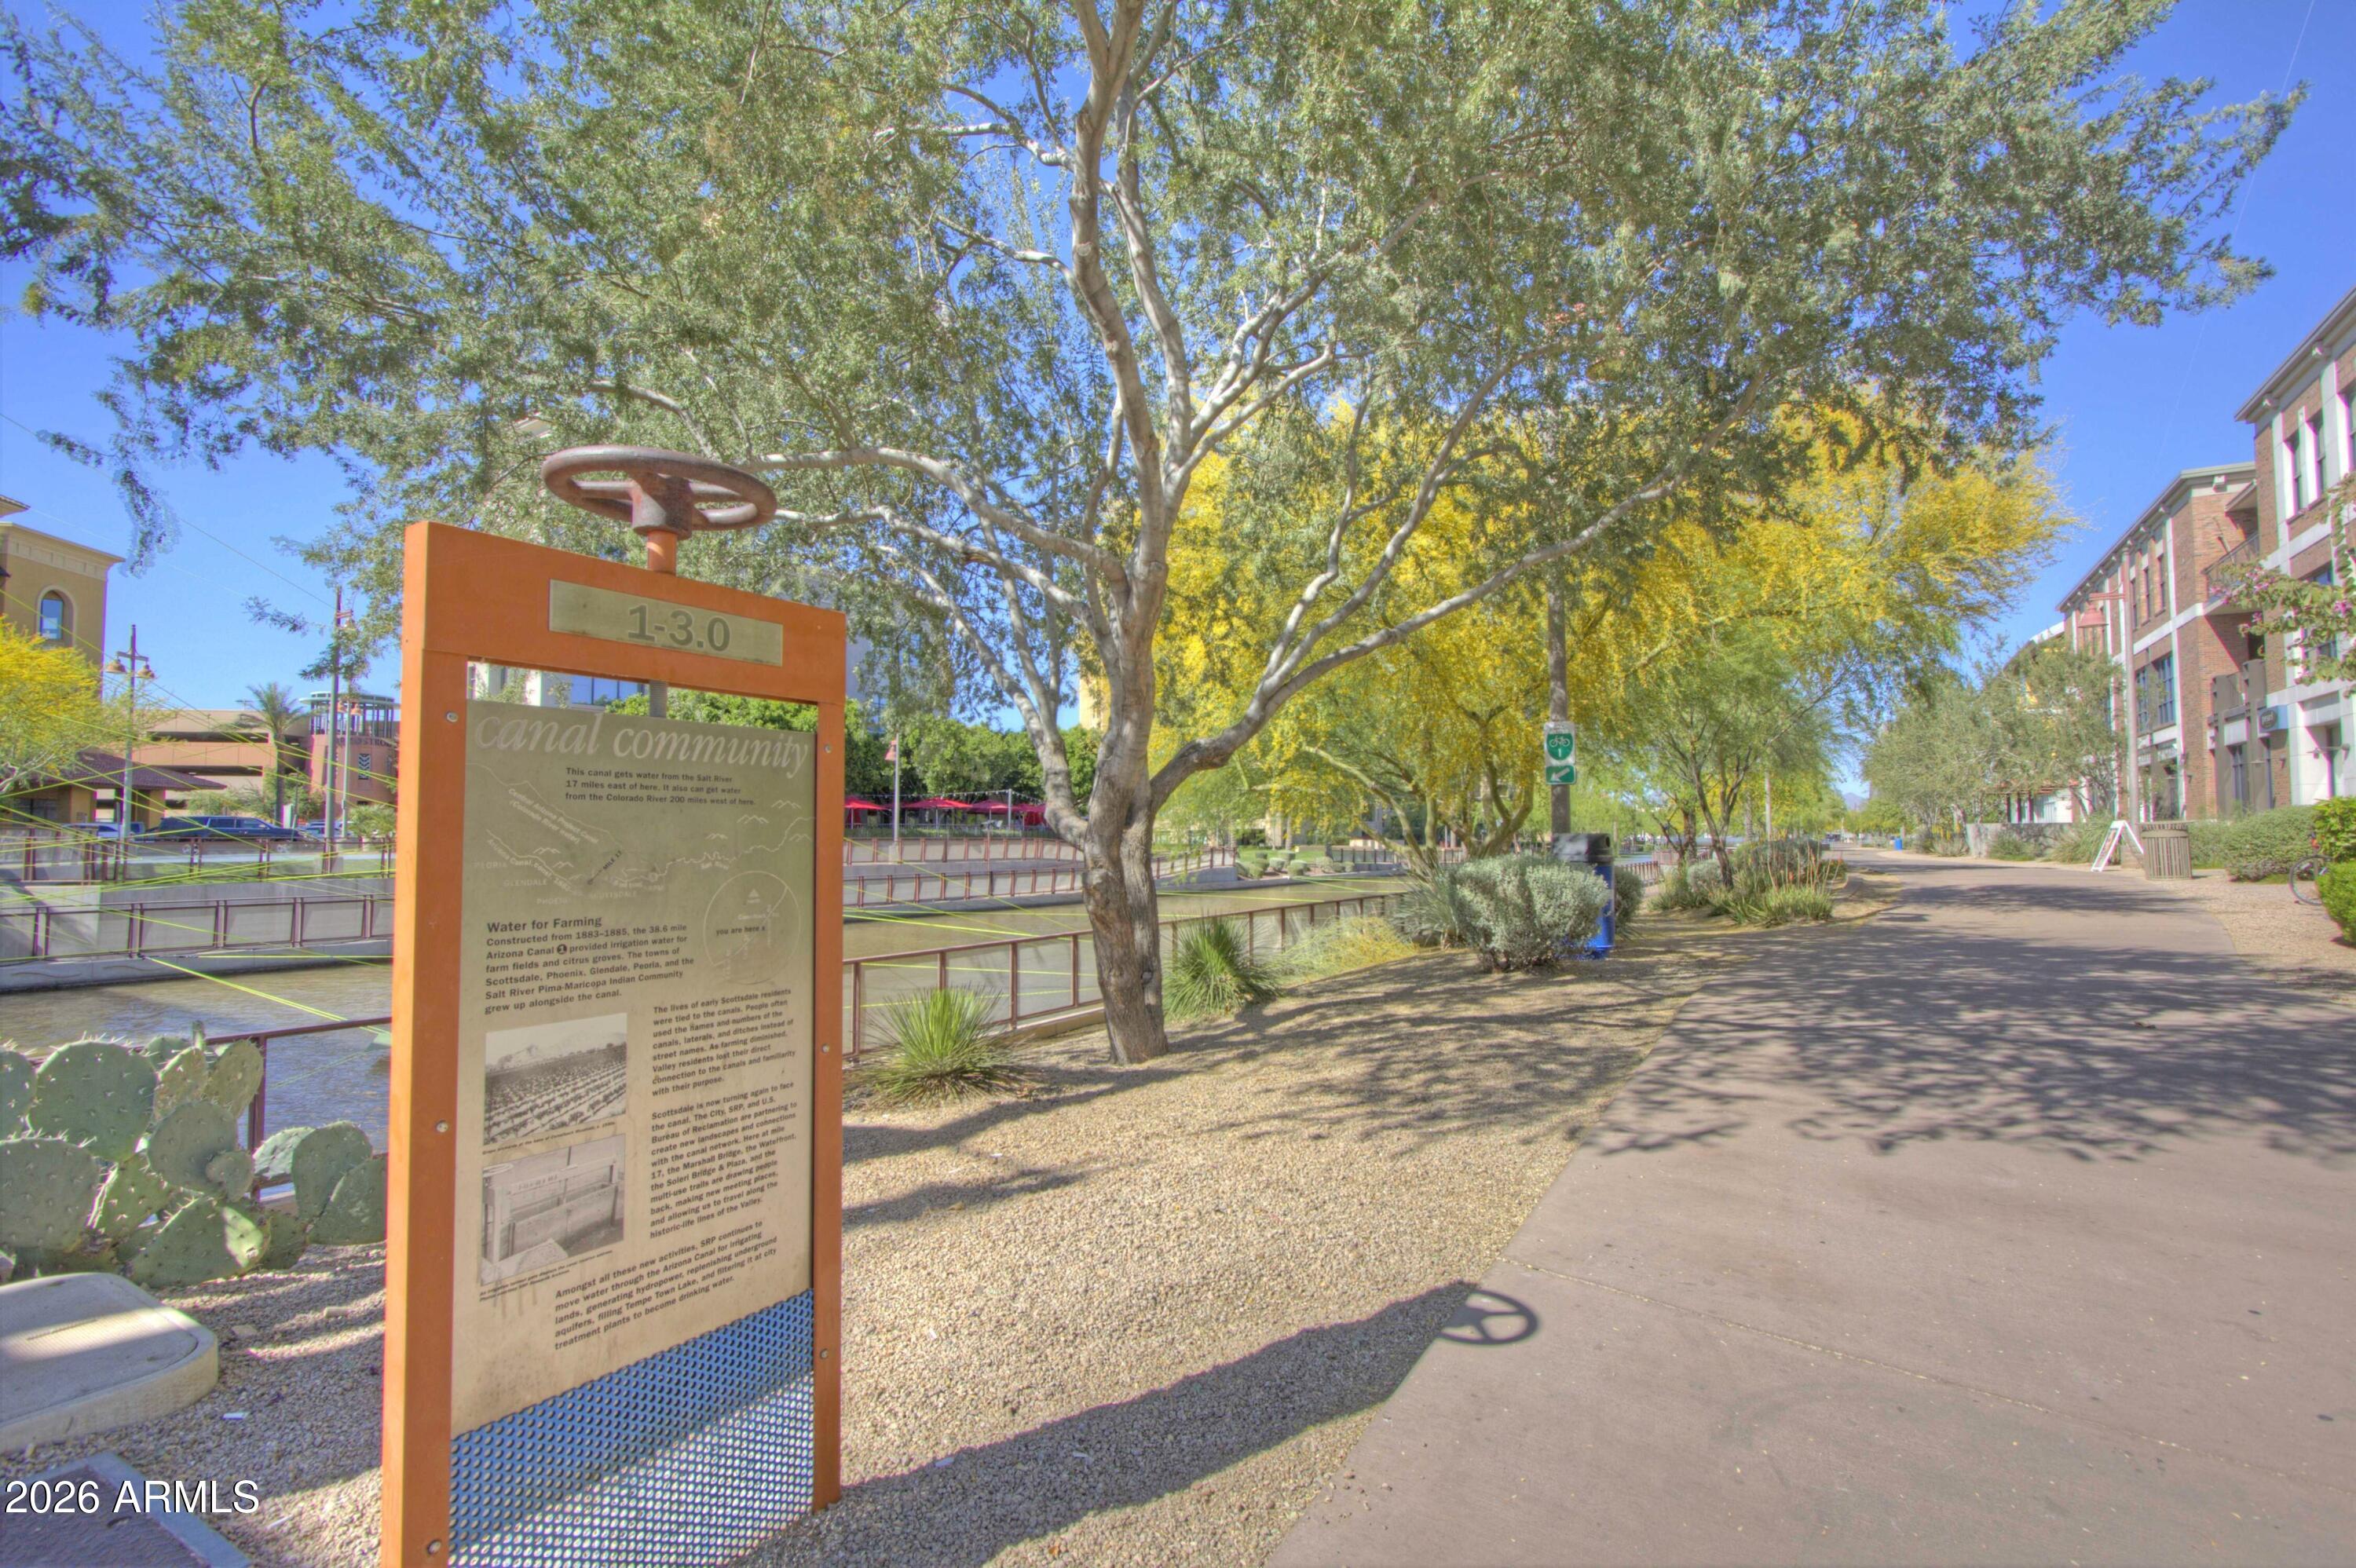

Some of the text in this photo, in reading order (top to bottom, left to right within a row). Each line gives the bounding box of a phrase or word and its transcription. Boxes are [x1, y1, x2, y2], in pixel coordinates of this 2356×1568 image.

[628, 604, 731, 652] 1-3.0
[476, 711, 810, 779] canal community
[605, 793, 644, 802] Colorado
[486, 934, 547, 945] Constructed
[487, 917, 602, 932] Water for Farming
[485, 950, 523, 959] Arizona
[526, 947, 554, 956] Canal
[569, 942, 607, 952] provided
[610, 939, 648, 948] irrigation
[512, 961, 539, 970] fields
[485, 990, 505, 999] Salt
[509, 988, 534, 996] River
[538, 980, 606, 992] Pima-Maricopa
[638, 970, 682, 981] Community
[484, 1004, 510, 1014] grew
[529, 996, 574, 1007] alongside
[651, 1105, 694, 1119] Scottsdale
[722, 1092, 748, 1102] turning
[750, 1087, 769, 1097] again
[554, 1278, 595, 1298] Amongst
[598, 1273, 609, 1283] all
[612, 1266, 636, 1277] these
[638, 1259, 656, 1268] new
[700, 1236, 715, 1247] SRP
[718, 1225, 752, 1241] continues
[554, 1298, 580, 1311] move
[582, 1288, 609, 1300] water
[610, 1274, 644, 1290] through
[646, 1269, 660, 1277] the
[662, 1258, 692, 1272] Arizona
[693, 1248, 715, 1260] Canal
[730, 1232, 762, 1247] irrigating
[586, 1291, 633, 1314] generating
[686, 1254, 732, 1274] replenishing
[734, 1237, 777, 1256] underground
[598, 1307, 622, 1320] filling
[624, 1296, 652, 1309] Tempe
[654, 1287, 675, 1298] Town
[701, 1270, 715, 1281] and
[716, 1260, 744, 1274] filtering
[554, 1327, 600, 1349] treatment
[603, 1316, 630, 1332] plants
[644, 1299, 676, 1314] become
[679, 1285, 710, 1301] drinking
